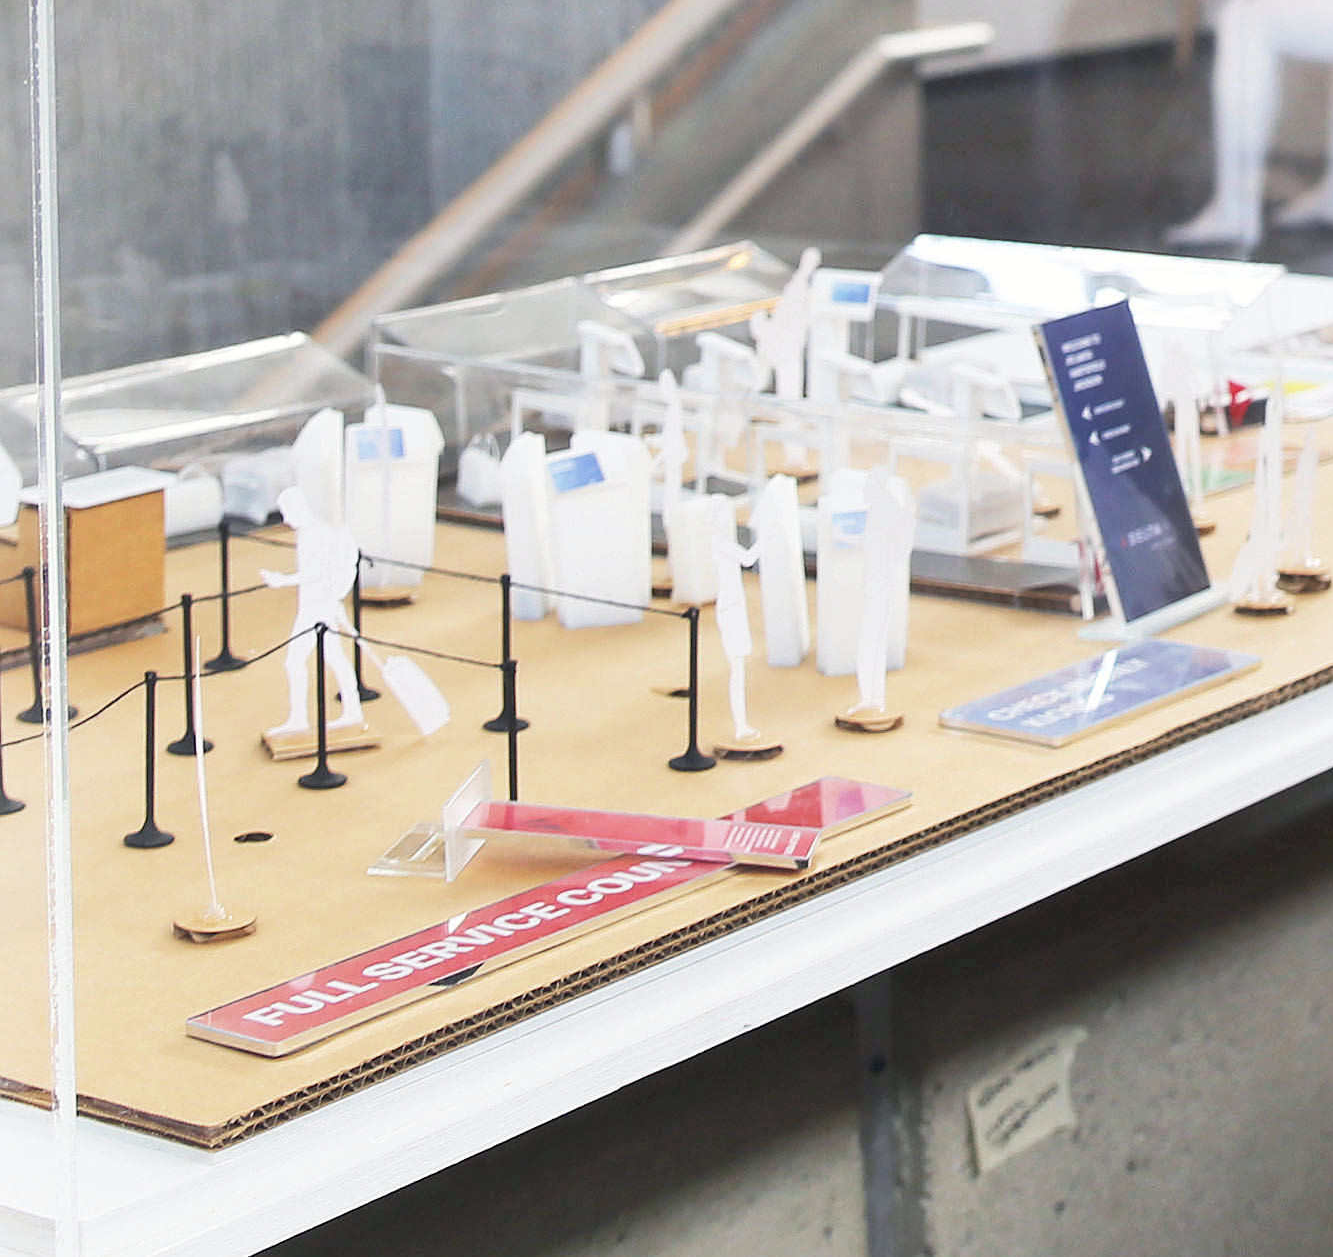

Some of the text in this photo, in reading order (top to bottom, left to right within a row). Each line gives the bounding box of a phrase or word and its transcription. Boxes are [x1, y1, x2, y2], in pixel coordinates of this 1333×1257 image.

[242, 858, 695, 1028] FULL SERVICE COUN
